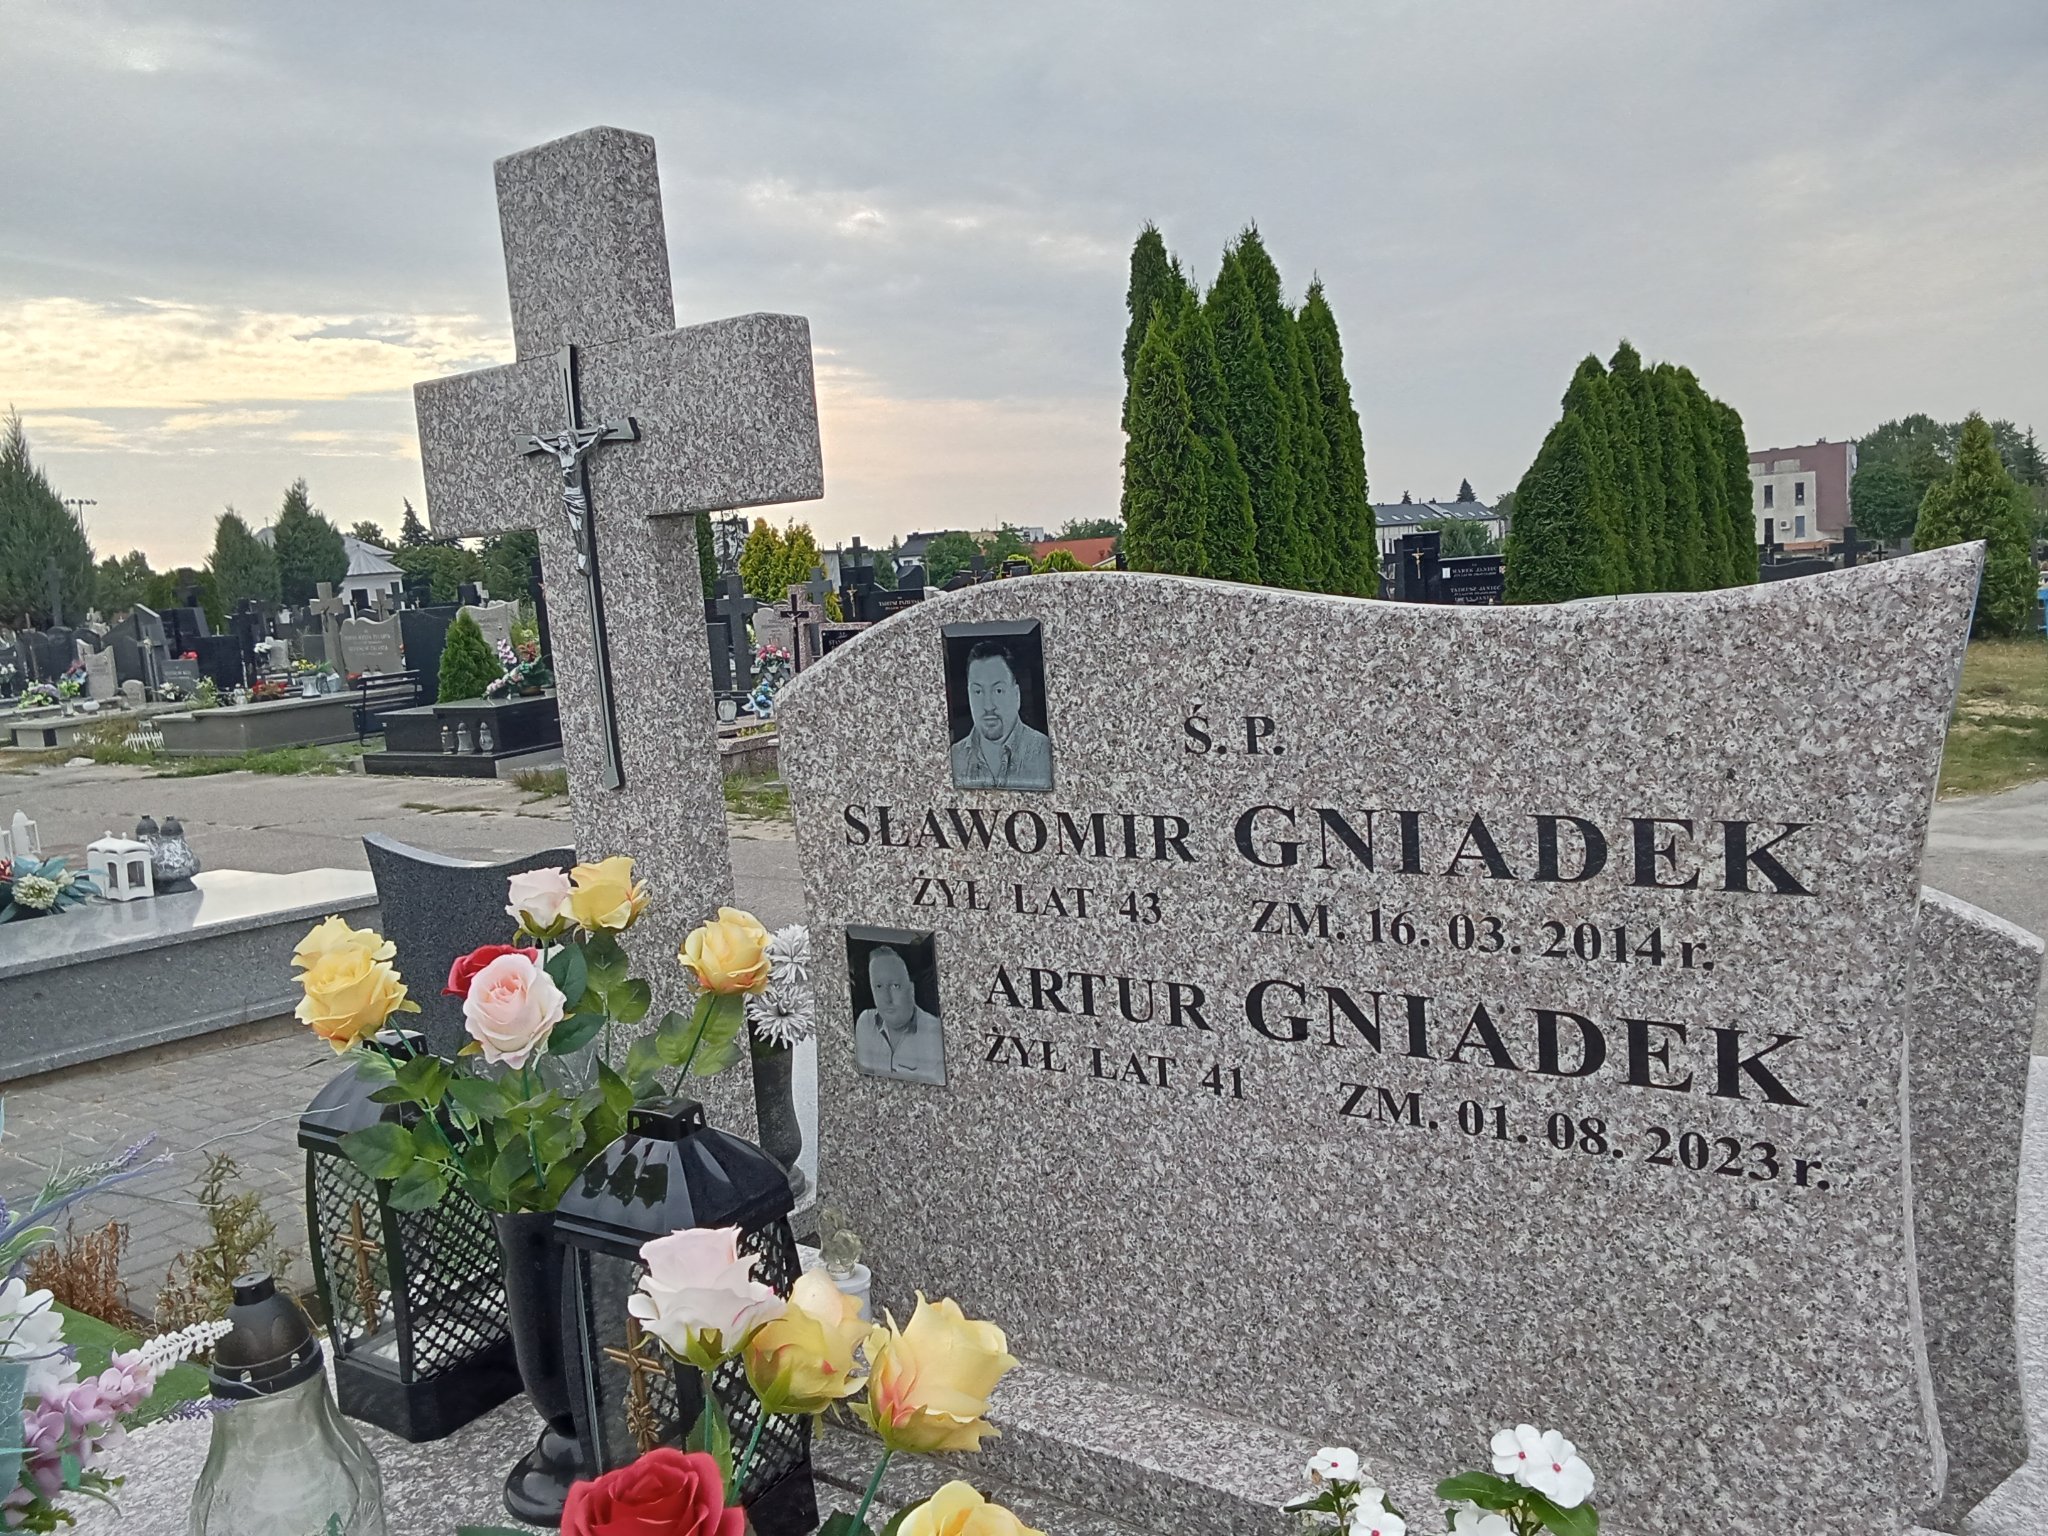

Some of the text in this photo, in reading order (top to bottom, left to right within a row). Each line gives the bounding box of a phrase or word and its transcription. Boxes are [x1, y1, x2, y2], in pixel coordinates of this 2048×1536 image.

[843, 803, 1818, 897] SŁAWOMIR GNIADEK
[911, 869, 1163, 924] ŻYŁ LAT 43
[1250, 900, 1346, 940] ZM.
[984, 963, 1809, 1108] ARTUR GNIADEK
[984, 1026, 1245, 1100] ŻYŁ LAT 41
[1338, 1082, 1439, 1130] ZM.
